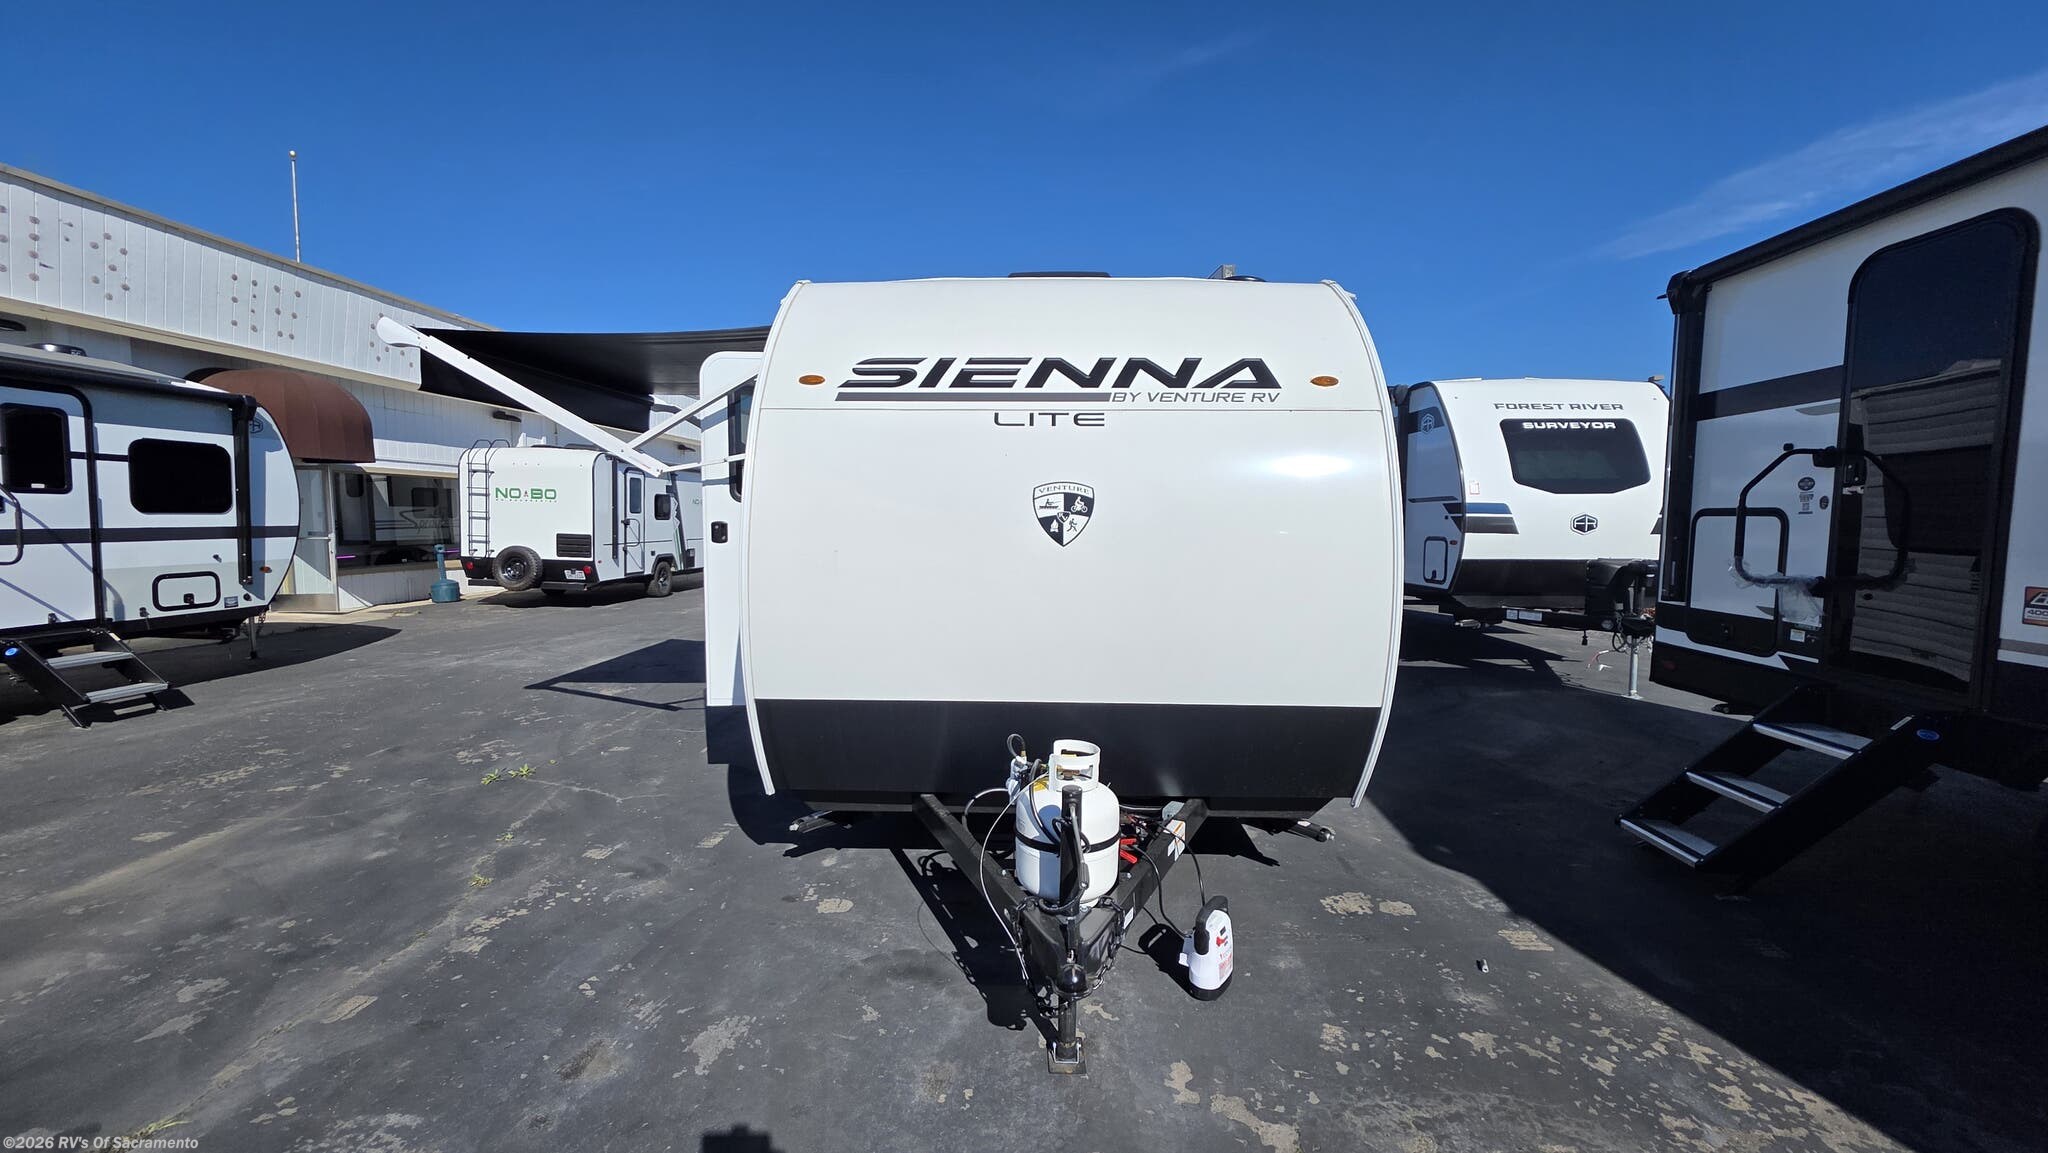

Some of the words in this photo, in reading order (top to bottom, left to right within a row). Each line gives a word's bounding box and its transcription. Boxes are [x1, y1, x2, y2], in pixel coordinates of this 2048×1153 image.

[837, 357, 1282, 389] SIENNA
[1111, 392, 1142, 403] BY
[1147, 392, 1247, 403] VENTURE
[1251, 392, 1281, 403] RV
[993, 412, 1106, 427] LITE
[1522, 421, 1617, 430] SURVEYOR
[1038, 485, 1090, 495] VENTURE
